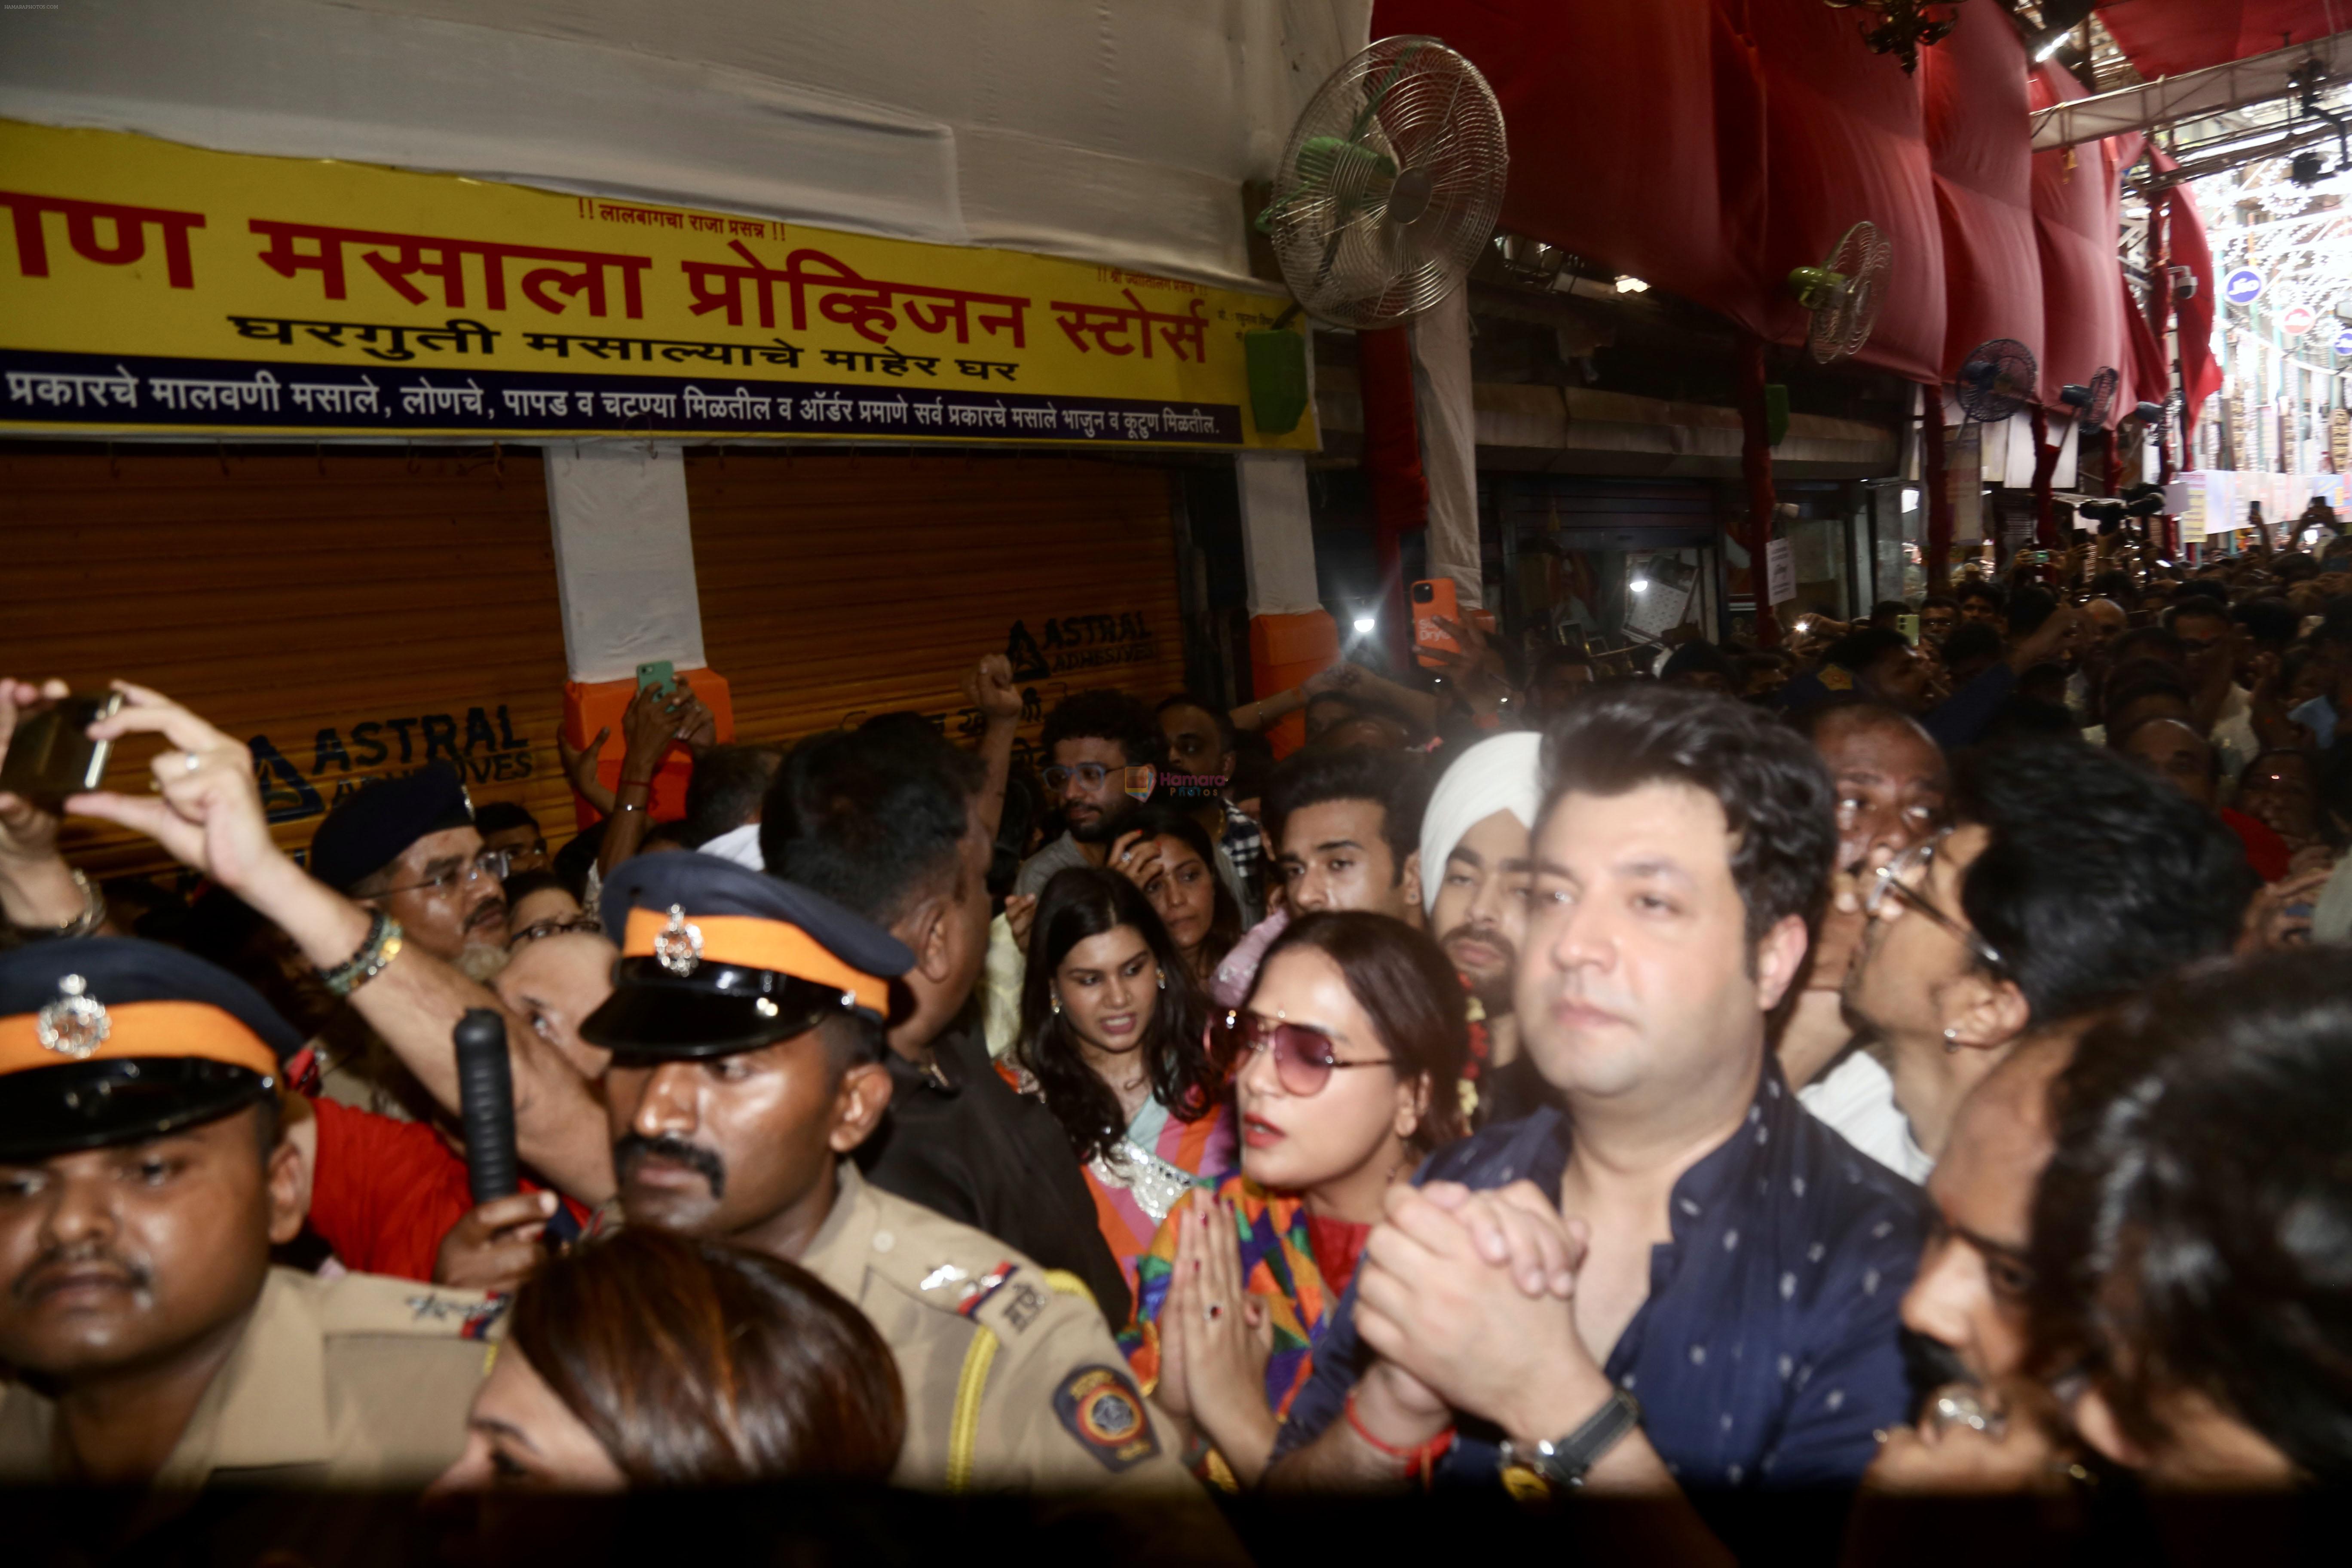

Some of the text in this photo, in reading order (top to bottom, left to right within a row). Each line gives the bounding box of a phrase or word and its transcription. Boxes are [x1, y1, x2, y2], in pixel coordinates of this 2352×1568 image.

[599, 204, 683, 229] लालबागचा
[689, 214, 724, 234] राजा
[729, 219, 765, 239] प्रसन्न
[0, 192, 1210, 364] ाण मसाला प्रोव्हिजन स्टोर्स
[227, 315, 1020, 382] घरगुती मसाल्याचे माहेर घर
[5, 363, 139, 409] प्रकारचे
[148, 369, 282, 412] मालवणी
[502, 389, 569, 416] पापड
[575, 391, 594, 417] व
[600, 392, 677, 419] चटण्या
[683, 384, 772, 421] मिळतील
[777, 397, 793, 421] व
[799, 390, 854, 422] ऑर्डर
[858, 393, 908, 424] प्रमाणे
[913, 395, 943, 426] सर्व
[948, 399, 1007, 428] प्रकारचे
[1011, 401, 1058, 429] मसाले
[1061, 409, 1105, 438] भाजुन
[1108, 411, 1119, 430] व
[1042, 609, 1153, 651] ASTRAL
[1052, 643, 1155, 672] ADHESIVES
[312, 704, 529, 775] ASTRAL
